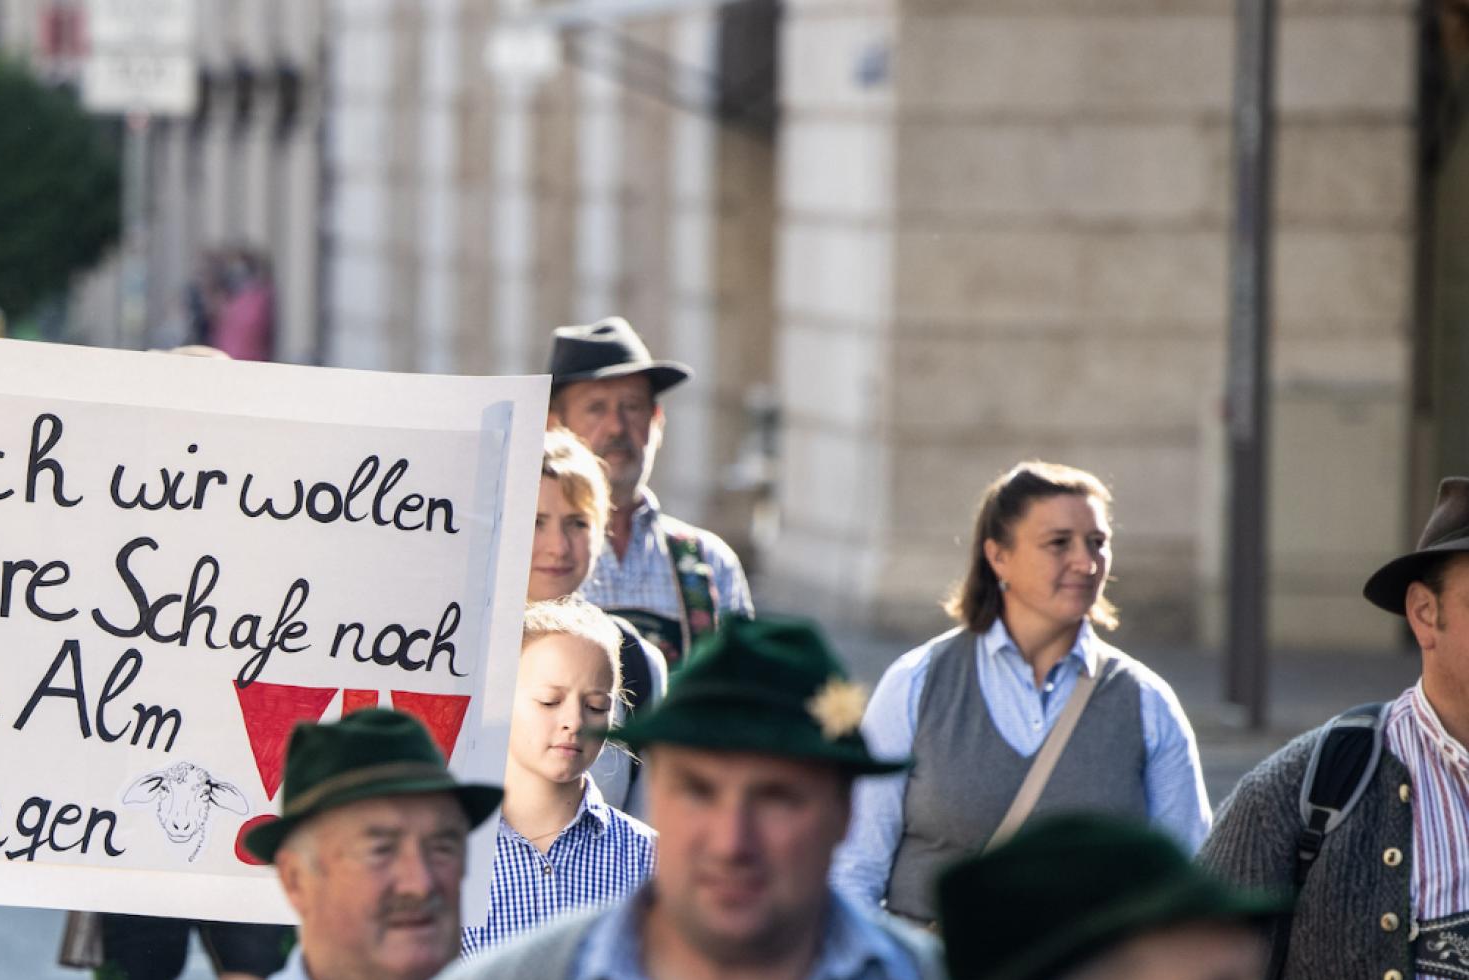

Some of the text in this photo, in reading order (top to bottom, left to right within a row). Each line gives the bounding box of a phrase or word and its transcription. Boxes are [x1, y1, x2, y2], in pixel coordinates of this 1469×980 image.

[109, 443, 229, 512] wir
[237, 453, 460, 535] wollen
[91, 536, 311, 689] Schafe
[329, 601, 470, 678] noch
[13, 638, 182, 753] Alm
